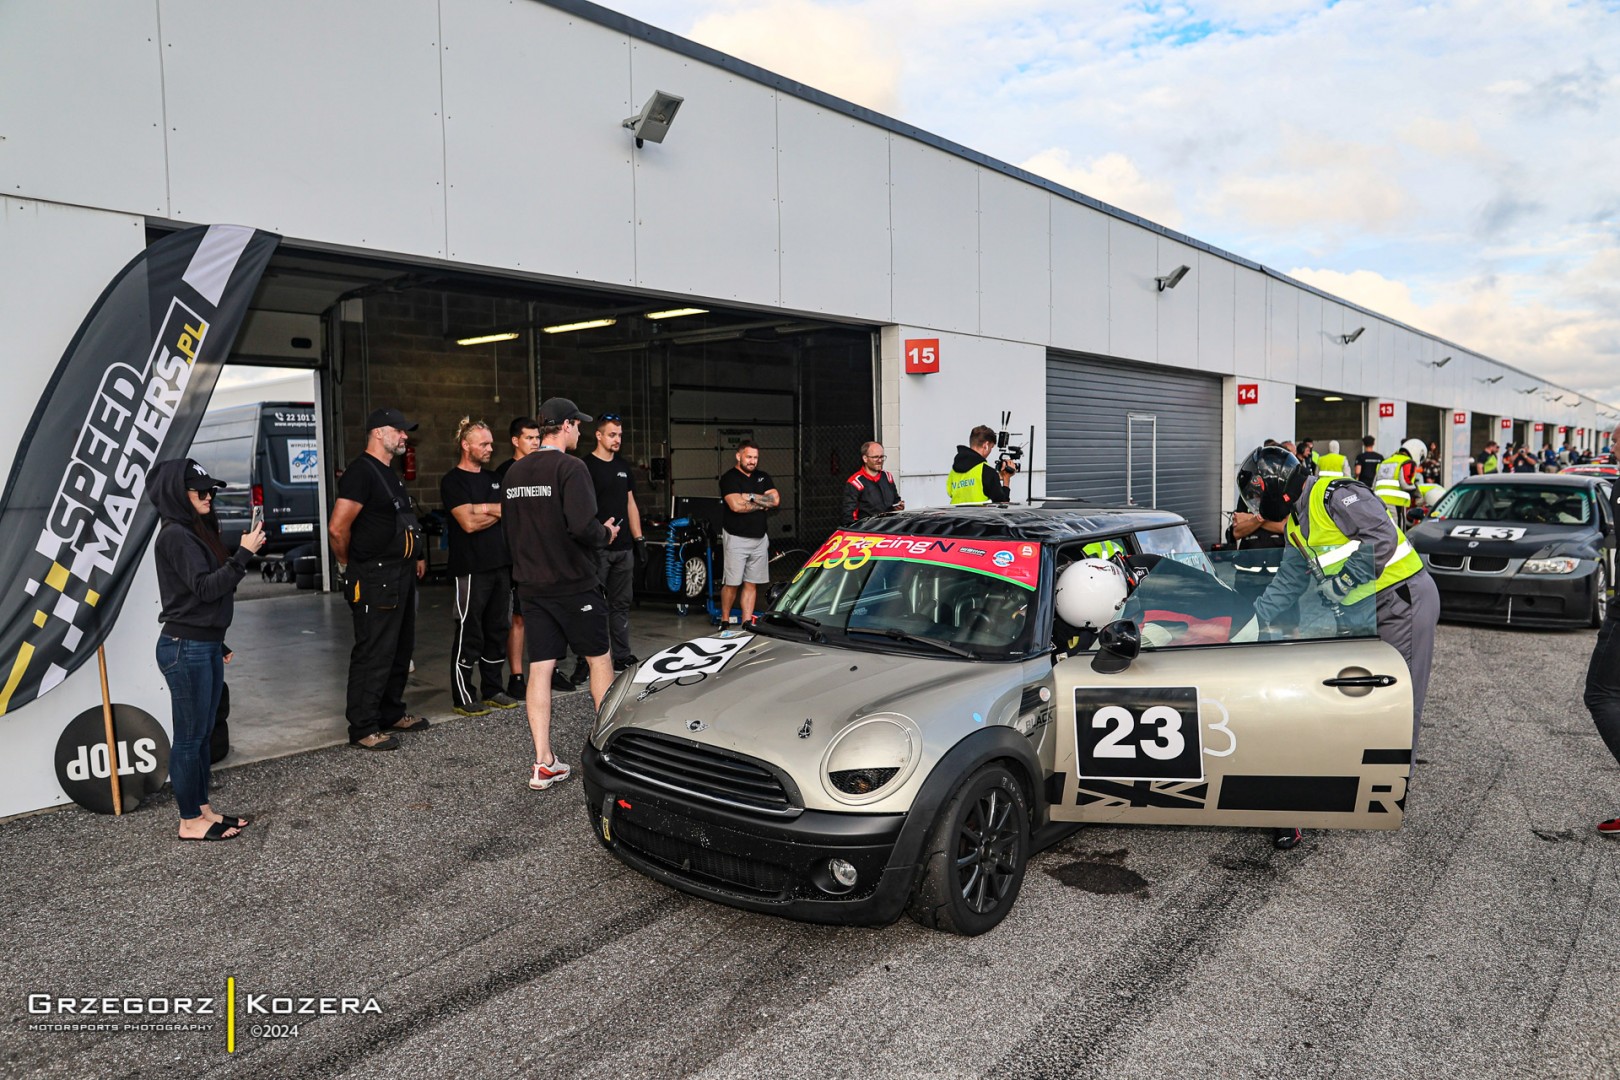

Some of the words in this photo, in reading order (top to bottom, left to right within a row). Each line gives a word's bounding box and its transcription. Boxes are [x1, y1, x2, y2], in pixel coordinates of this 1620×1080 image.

[908, 347, 935, 365] 15
[1239, 388, 1256, 400] 14
[1380, 407, 1393, 415] 13
[49, 363, 145, 542] SPEED
[1457, 527, 1515, 540] 43
[806, 535, 886, 571] 233
[1091, 705, 1186, 761] 23
[66, 737, 158, 781] STOP
